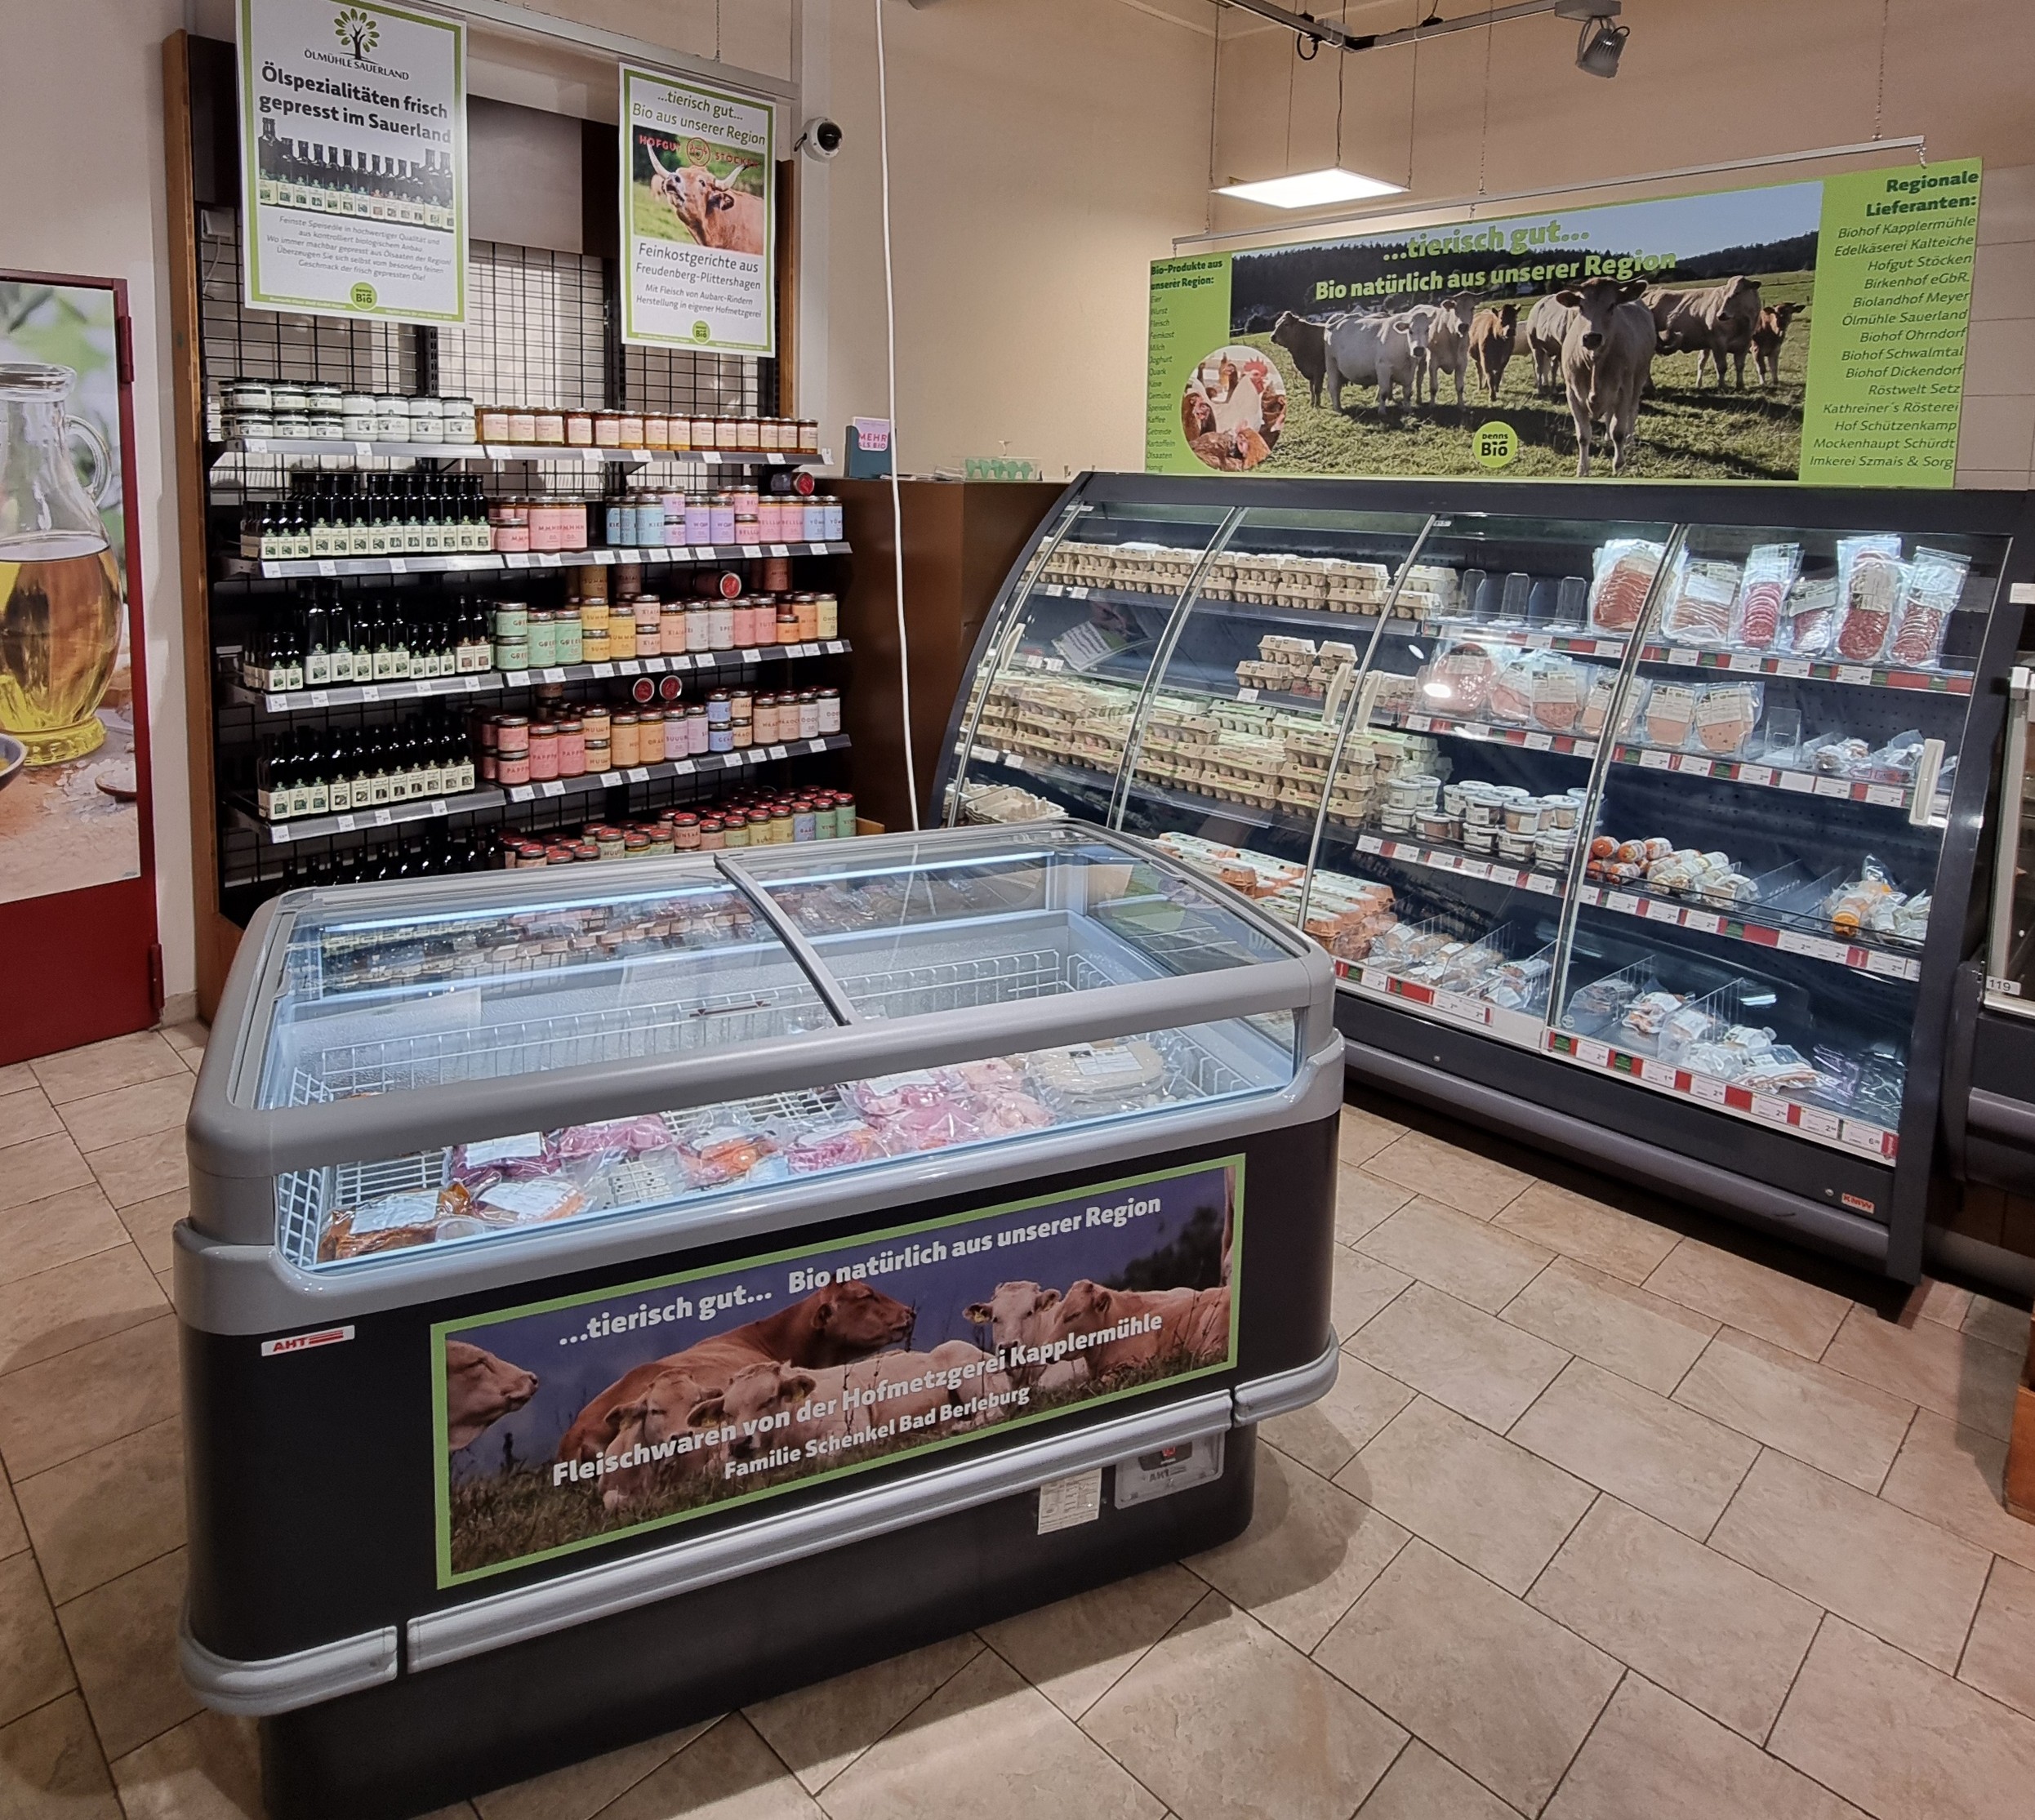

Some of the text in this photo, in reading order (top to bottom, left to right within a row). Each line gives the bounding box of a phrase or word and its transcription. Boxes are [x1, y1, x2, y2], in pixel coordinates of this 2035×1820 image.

[304, 49, 408, 80] ÖLMÜHLE SAUERLAND
[262, 60, 448, 119] Ölspezialitäten frisch
[657, 91, 710, 112] ...tierisch
[260, 96, 451, 144] gepresst im Sauerland
[633, 103, 765, 145] Bio aus unserer Region
[1886, 171, 1979, 194] Regionale
[1866, 195, 1977, 216] Lieferanten:
[1839, 216, 1975, 238] Biohof Kapplermühle
[306, 242, 336, 251] machbar
[1834, 235, 1974, 256] Edelkäserei Kalteiche
[639, 243, 759, 273] Feinkostgerichte aus
[1868, 255, 1973, 273] Hofgut Stöcken
[636, 262, 761, 291] Freudenberg-Plittershagen
[1151, 262, 1205, 275] Bio-Produkte
[1316, 249, 1676, 300] Bio natürlich aus unserer Region
[645, 284, 658, 292] Mit
[660, 286, 684, 296] Fleisch
[1182, 276, 1214, 288] Region:
[1864, 274, 1929, 289] Birkenhof
[636, 295, 678, 310] Herstellung
[688, 303, 714, 313] eigener
[715, 307, 761, 318] Hofmetzgerei
[1853, 291, 1970, 308] Biolandhof Meyer
[1842, 309, 1967, 327] Ölmühle Sauerland
[1859, 327, 1966, 342] Biohof Ohrndorf
[1841, 347, 1964, 361] Biohof Schwalmtal
[1846, 363, 1965, 378] Biohof Dickendorf
[1868, 383, 1961, 395] Röstwelt Setz
[1903, 402, 1959, 412] Rösterei
[1835, 420, 1957, 433] Hof Schützenkamp
[1814, 438, 1956, 451] Mockenhaupt Schürdt
[1810, 456, 1953, 470] Imkerei Szmais & Sorg
[1989, 980, 2011, 991] 119
[559, 1197, 1160, 1346] ...tierisch gut... Bio natürlich aus unserer Region
[273, 1338, 305, 1352] AHT
[553, 1315, 1162, 1486] Fleischwaren von der Hofmetzgerei Kapplermühle
[725, 1387, 1030, 1480] Familie Schenkel Bad Berleburg
